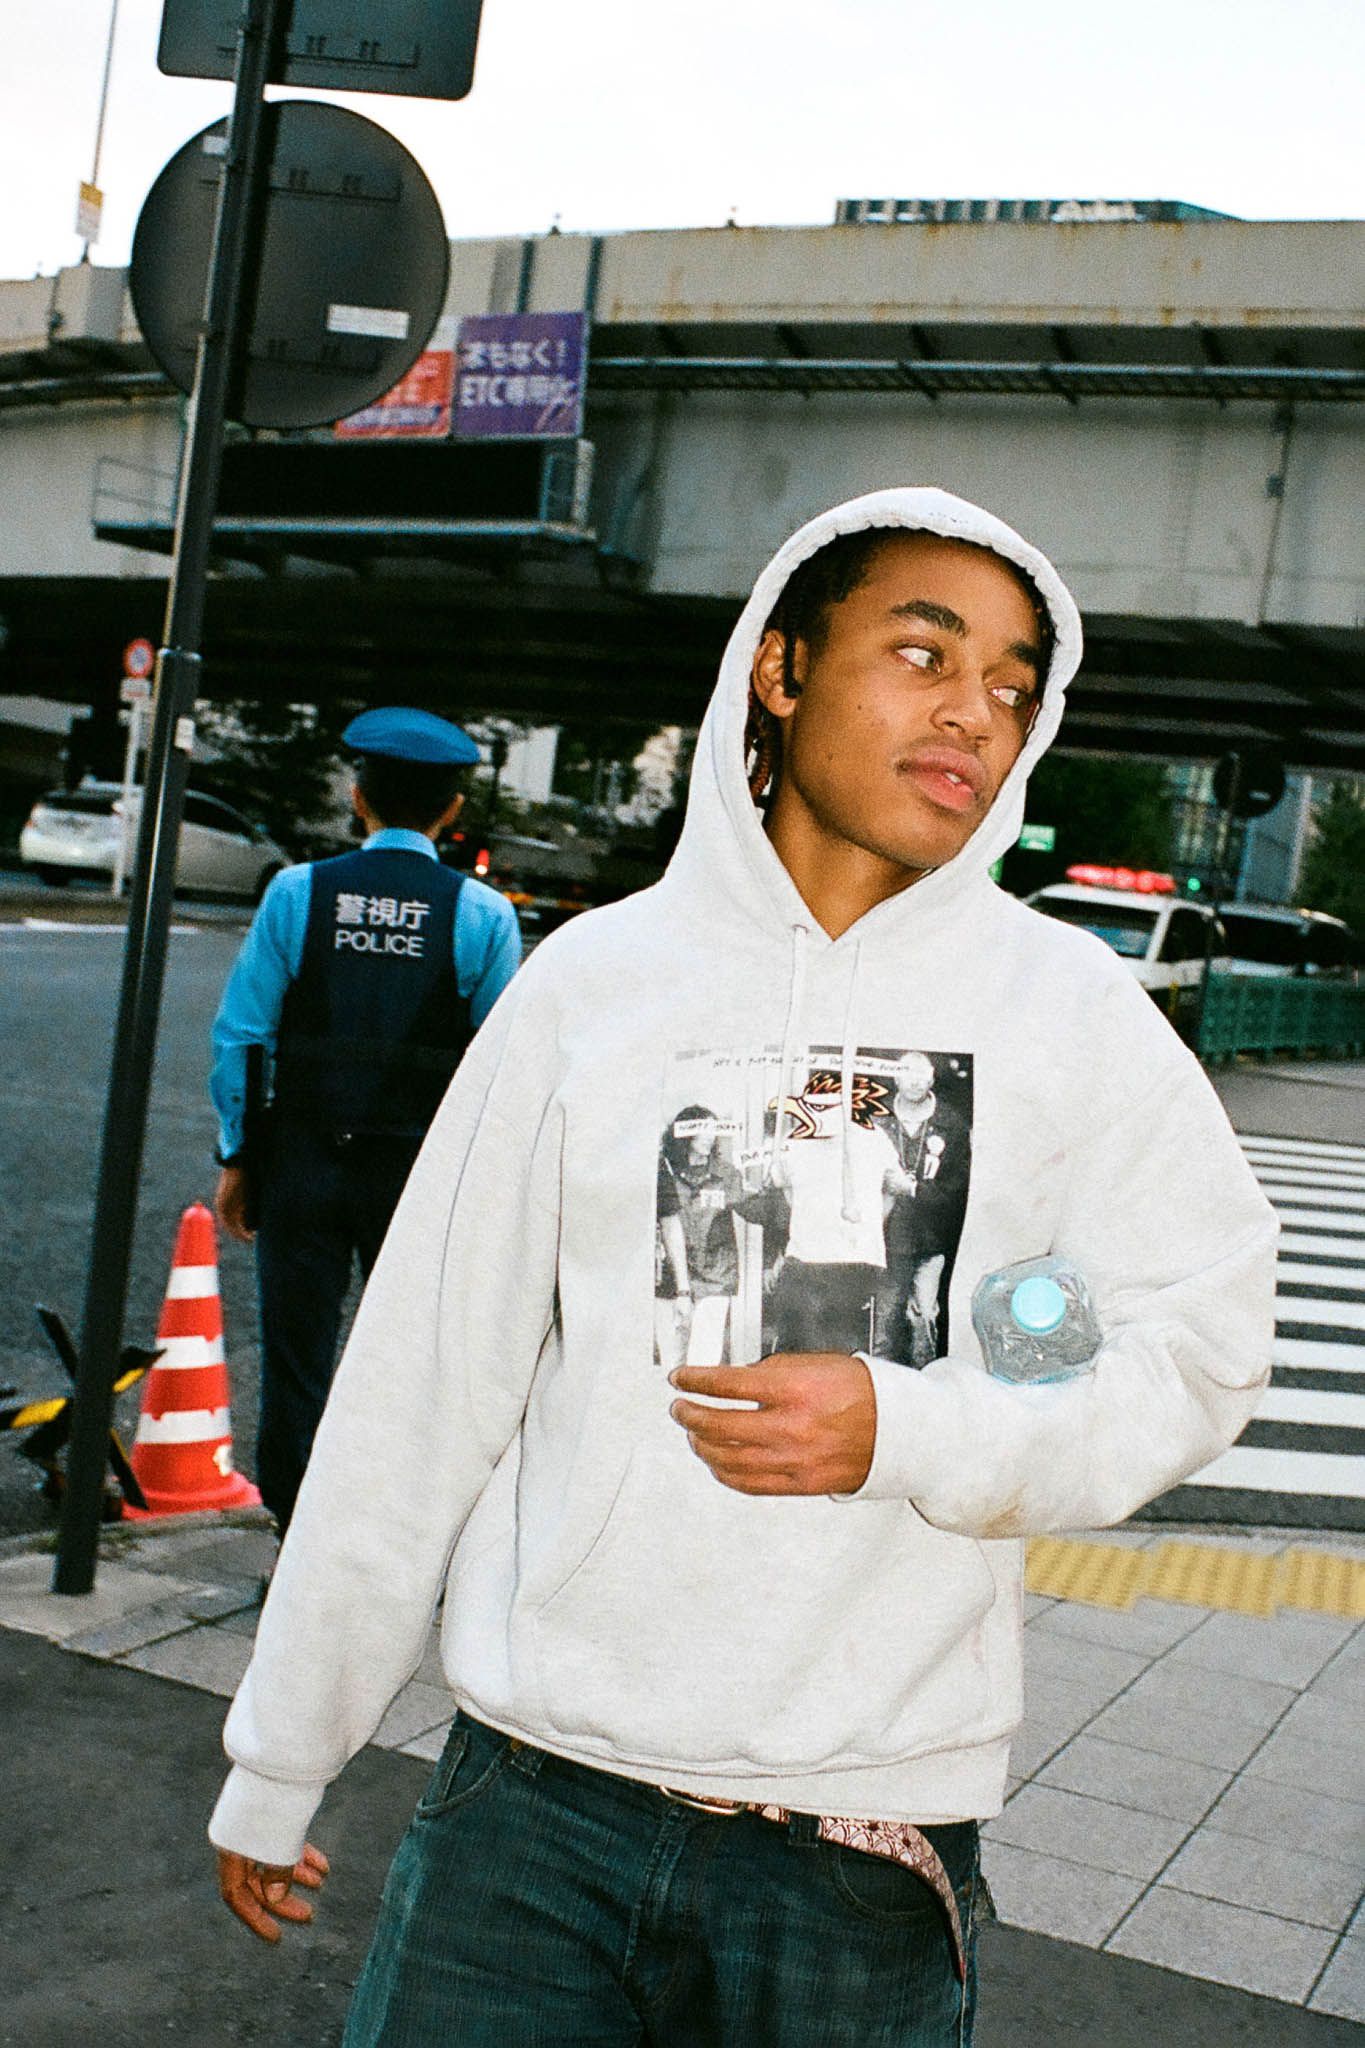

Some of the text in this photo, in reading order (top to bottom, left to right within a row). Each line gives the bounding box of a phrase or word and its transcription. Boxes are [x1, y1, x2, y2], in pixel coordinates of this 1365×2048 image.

[335, 893, 431, 930] 警視庁
[335, 929, 425, 957] POLICE
